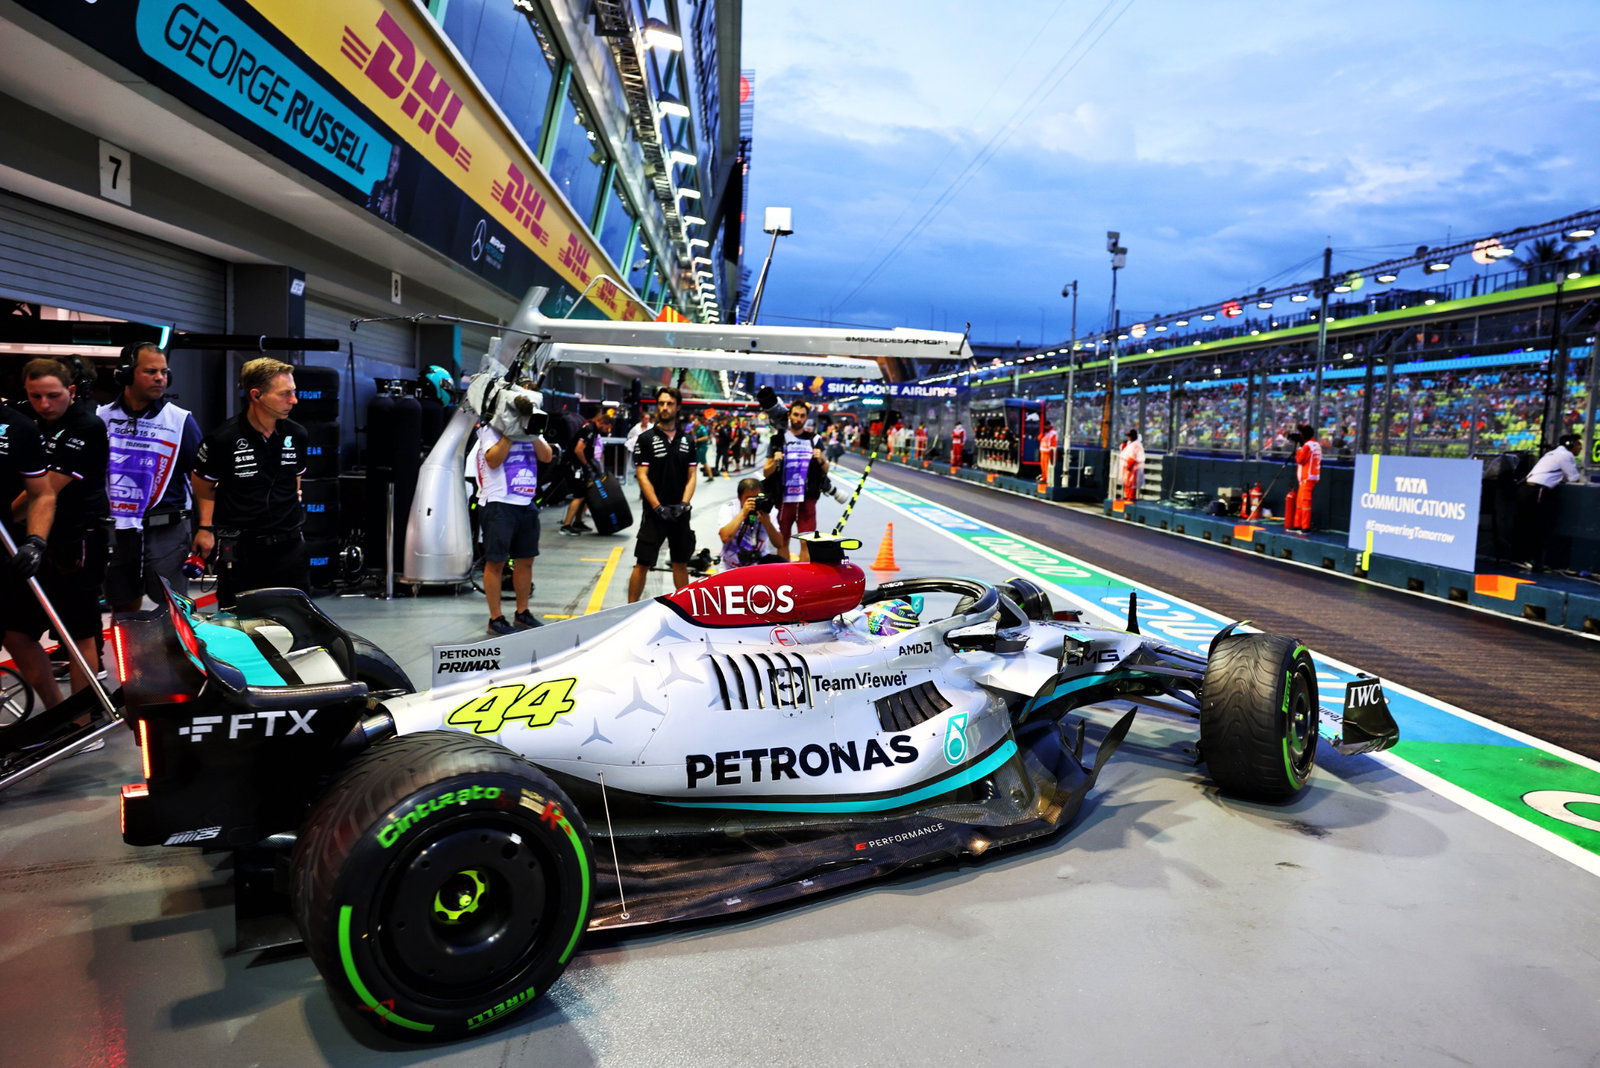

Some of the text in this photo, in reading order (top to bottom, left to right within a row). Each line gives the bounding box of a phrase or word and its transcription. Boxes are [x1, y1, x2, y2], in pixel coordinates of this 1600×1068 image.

[164, 2, 369, 175] GEORGE RUSSELL
[364, 10, 464, 158] DHL
[108, 155, 122, 190] 7
[501, 161, 547, 240] DHL
[299, 390, 323, 399] FRONT
[901, 385, 958, 398] AIRLINES
[306, 446, 323, 456] EAR
[1394, 476, 1429, 495] TATA
[306, 504, 325, 513] REAR
[1360, 492, 1467, 521] COMMUNICATIONS
[1366, 519, 1456, 544] #EmpoweringTomorrow
[309, 557, 329, 566] FRONT
[687, 583, 795, 616] INEOS
[439, 647, 502, 660] PETRONAS
[898, 643, 924, 656] AMD
[436, 659, 501, 674] PRIMAX
[811, 671, 908, 692] TeamViewer
[445, 676, 578, 736] 44
[1347, 683, 1381, 709] IWC
[228, 709, 319, 740] FTX
[685, 734, 919, 790] PETRONAS
[375, 784, 501, 849] Cinturato
[868, 822, 945, 848] PERFORMANCE
[467, 985, 537, 1028] PIRELLI
